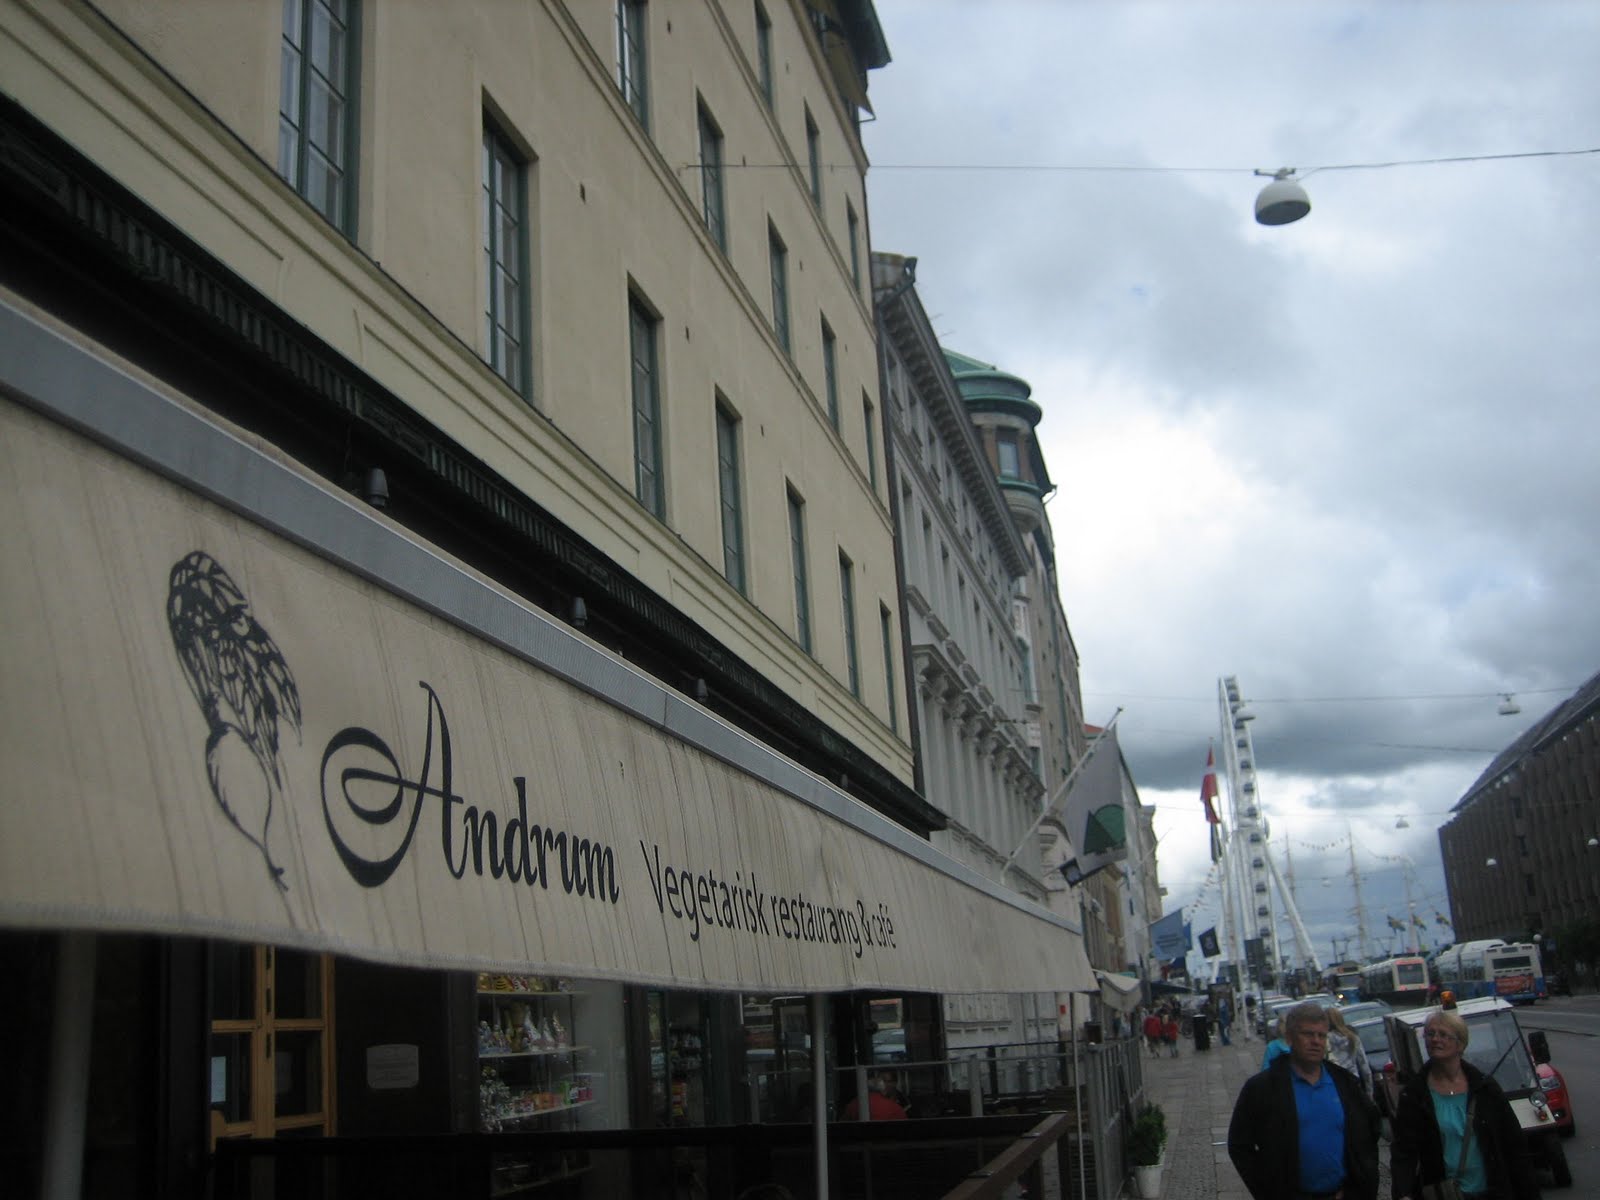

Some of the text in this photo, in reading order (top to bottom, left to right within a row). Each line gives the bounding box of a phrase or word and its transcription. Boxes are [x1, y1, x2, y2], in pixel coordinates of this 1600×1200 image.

[320, 680, 897, 959] Andrum Vegetarisk restaurang & café
